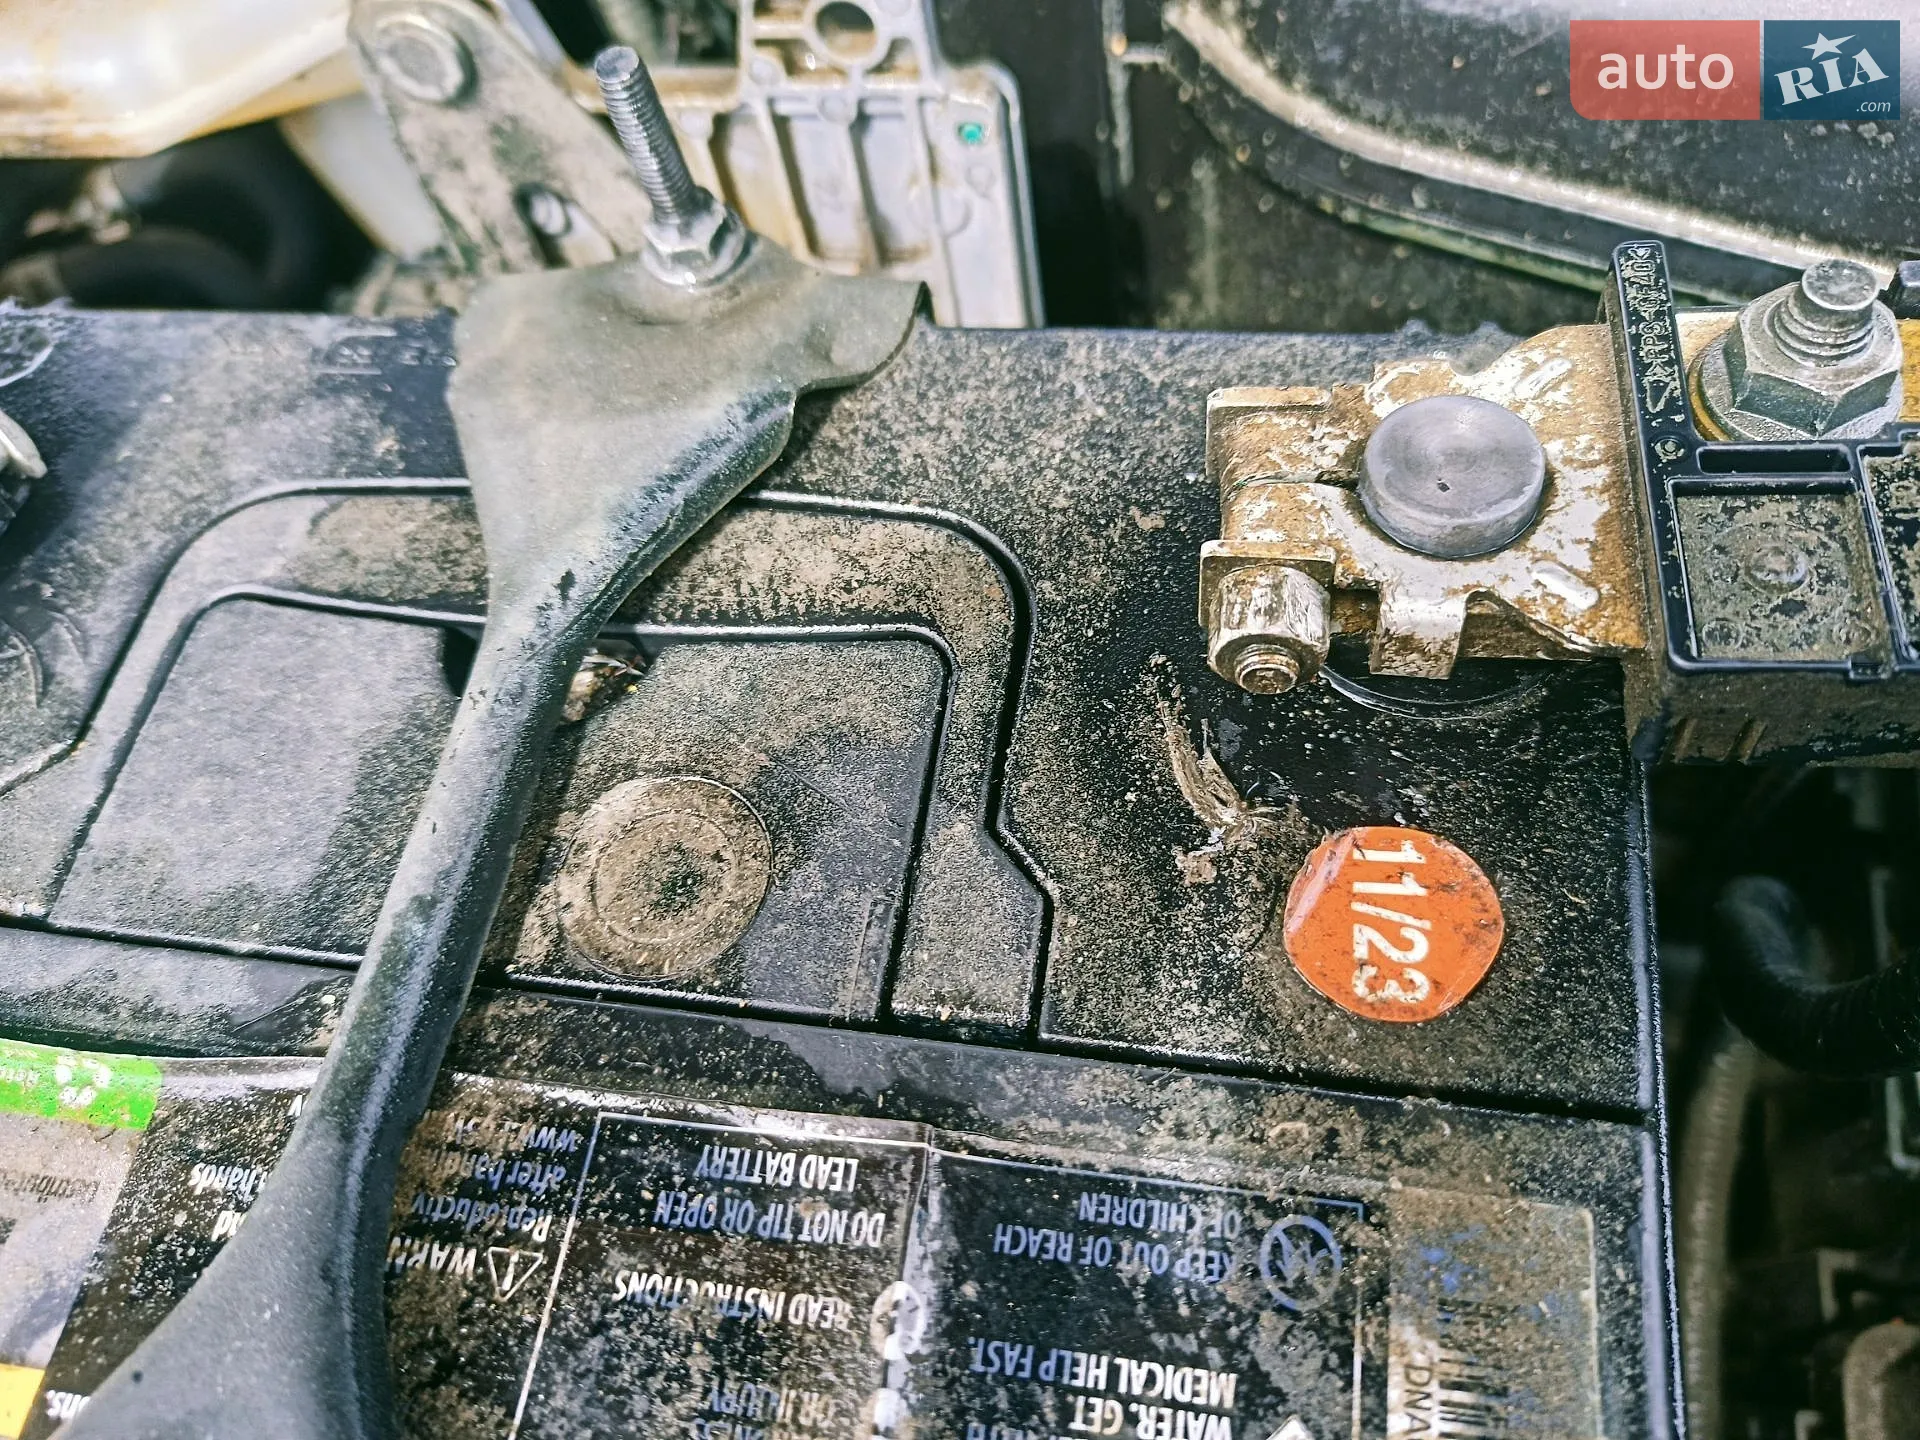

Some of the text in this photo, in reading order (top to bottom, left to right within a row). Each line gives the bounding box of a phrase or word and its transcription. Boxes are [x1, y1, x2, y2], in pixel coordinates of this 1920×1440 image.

[1351, 839, 1433, 1004] 11/23
[187, 1163, 256, 1201] hands
[506, 1160, 566, 1196] after
[693, 1144, 859, 1193] LEAD BATTERY
[405, 1194, 552, 1242] Reproductiv
[652, 1190, 886, 1248] DO NOT TIP OR OPEN
[1078, 1192, 1242, 1239] OF CHILDREN
[993, 1223, 1236, 1283] KEEP OUT OF REACH
[611, 1269, 786, 1323] INSTRUCTIONS
[967, 1337, 1237, 1408] MEDICAL HELP FAST.
[1402, 1362, 1434, 1440] DNA
